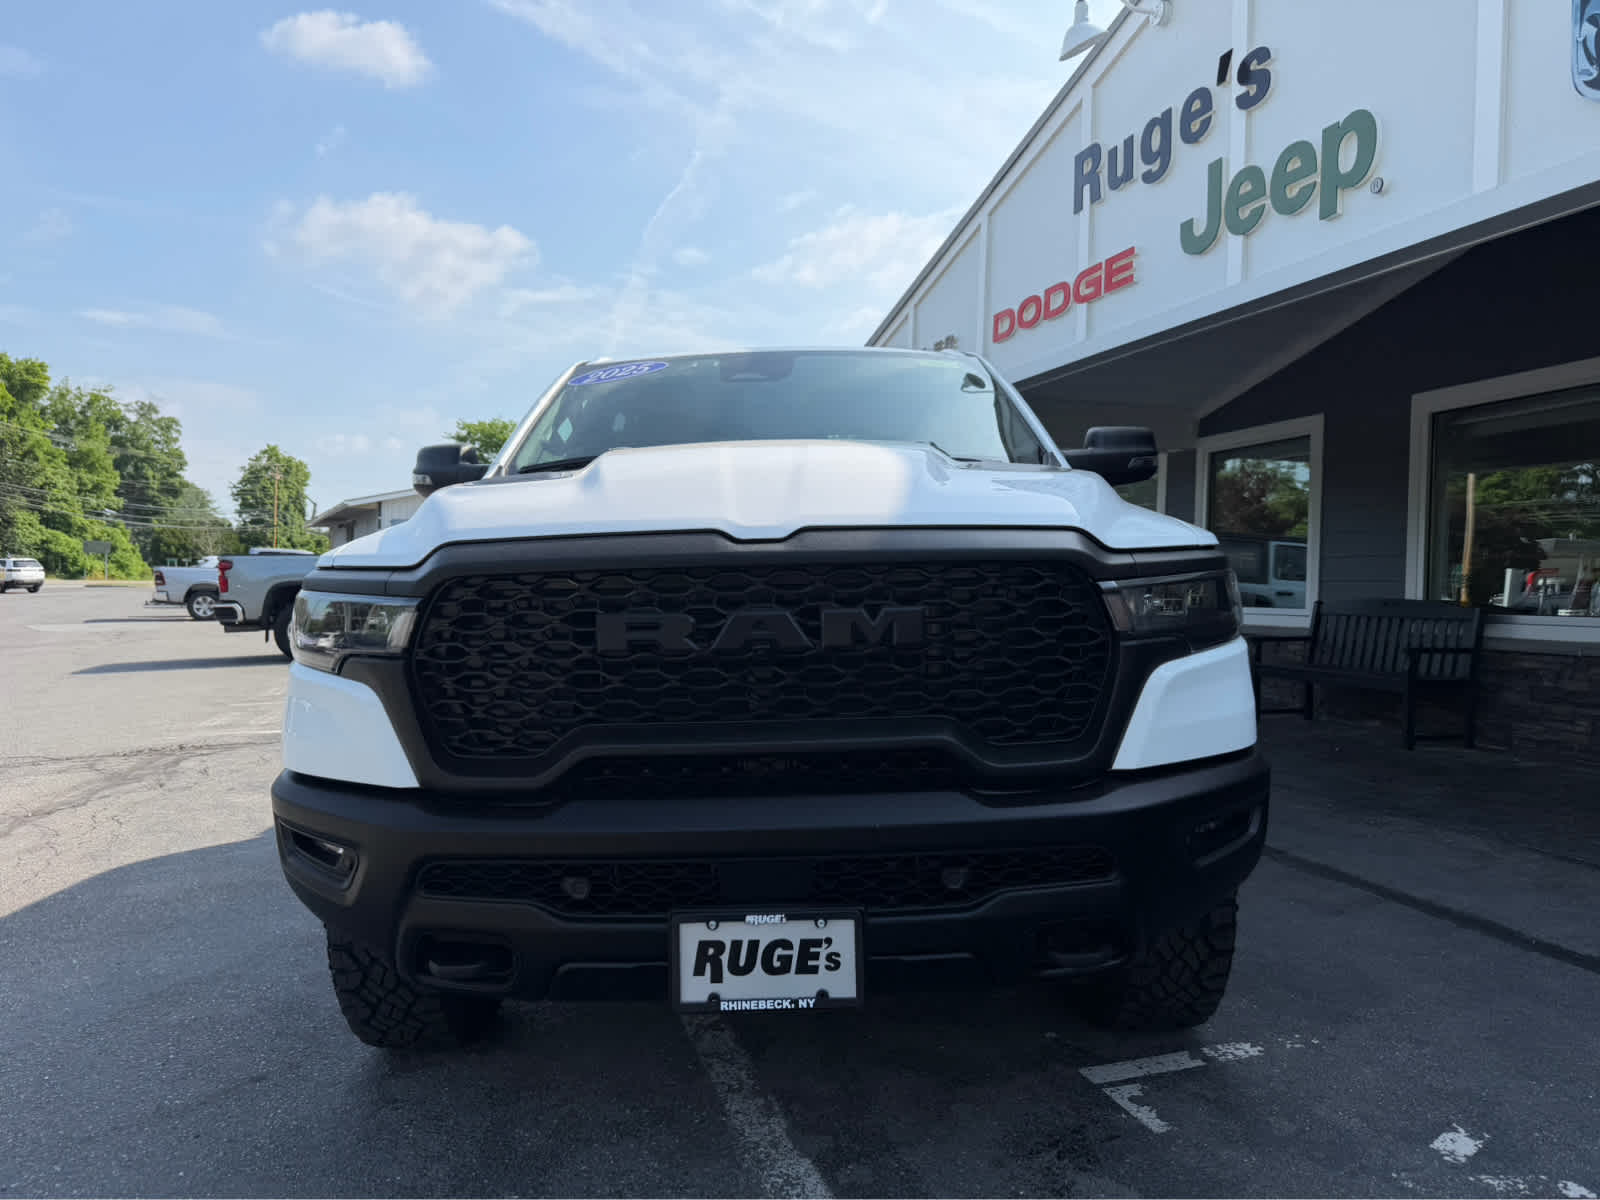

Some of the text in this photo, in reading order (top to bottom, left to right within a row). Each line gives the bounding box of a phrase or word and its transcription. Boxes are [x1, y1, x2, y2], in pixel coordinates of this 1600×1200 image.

[1073, 46, 1273, 214] Ruge's
[1180, 109, 1378, 255] Jeep
[993, 246, 1136, 344] DODGE
[584, 362, 652, 384] 2025
[596, 606, 926, 651] RAM
[692, 937, 842, 984] RUGE's
[798, 998, 816, 1009] NY
